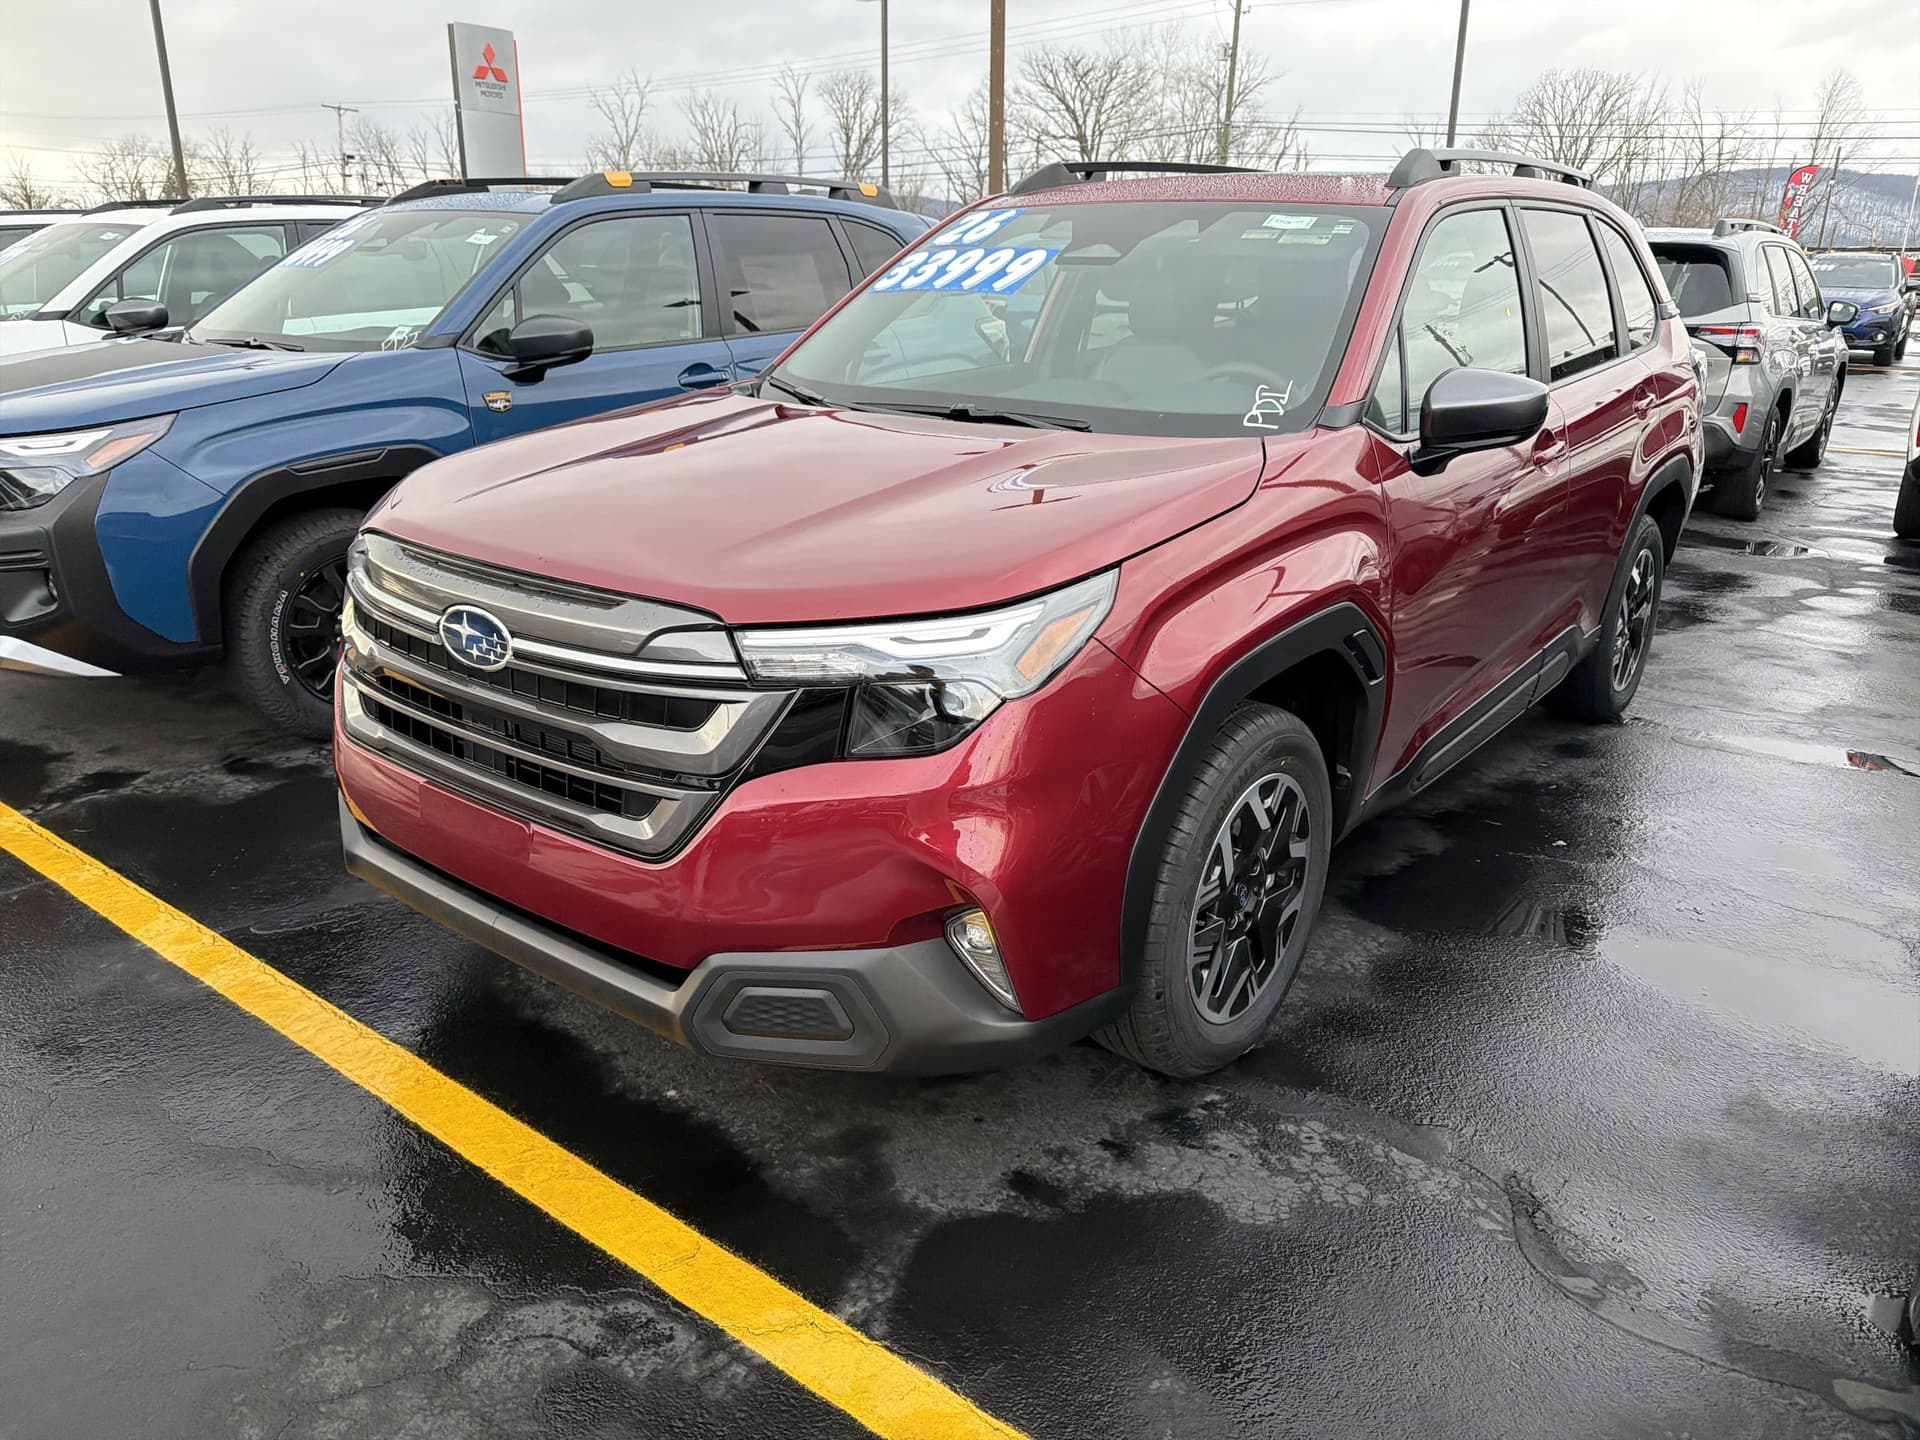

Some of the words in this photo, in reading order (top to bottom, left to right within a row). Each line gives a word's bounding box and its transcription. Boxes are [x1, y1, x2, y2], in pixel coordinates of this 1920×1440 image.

[933, 209, 1017, 245] 26
[874, 248, 1048, 292] 33999
[270, 590, 290, 684] YOKOHAMA
